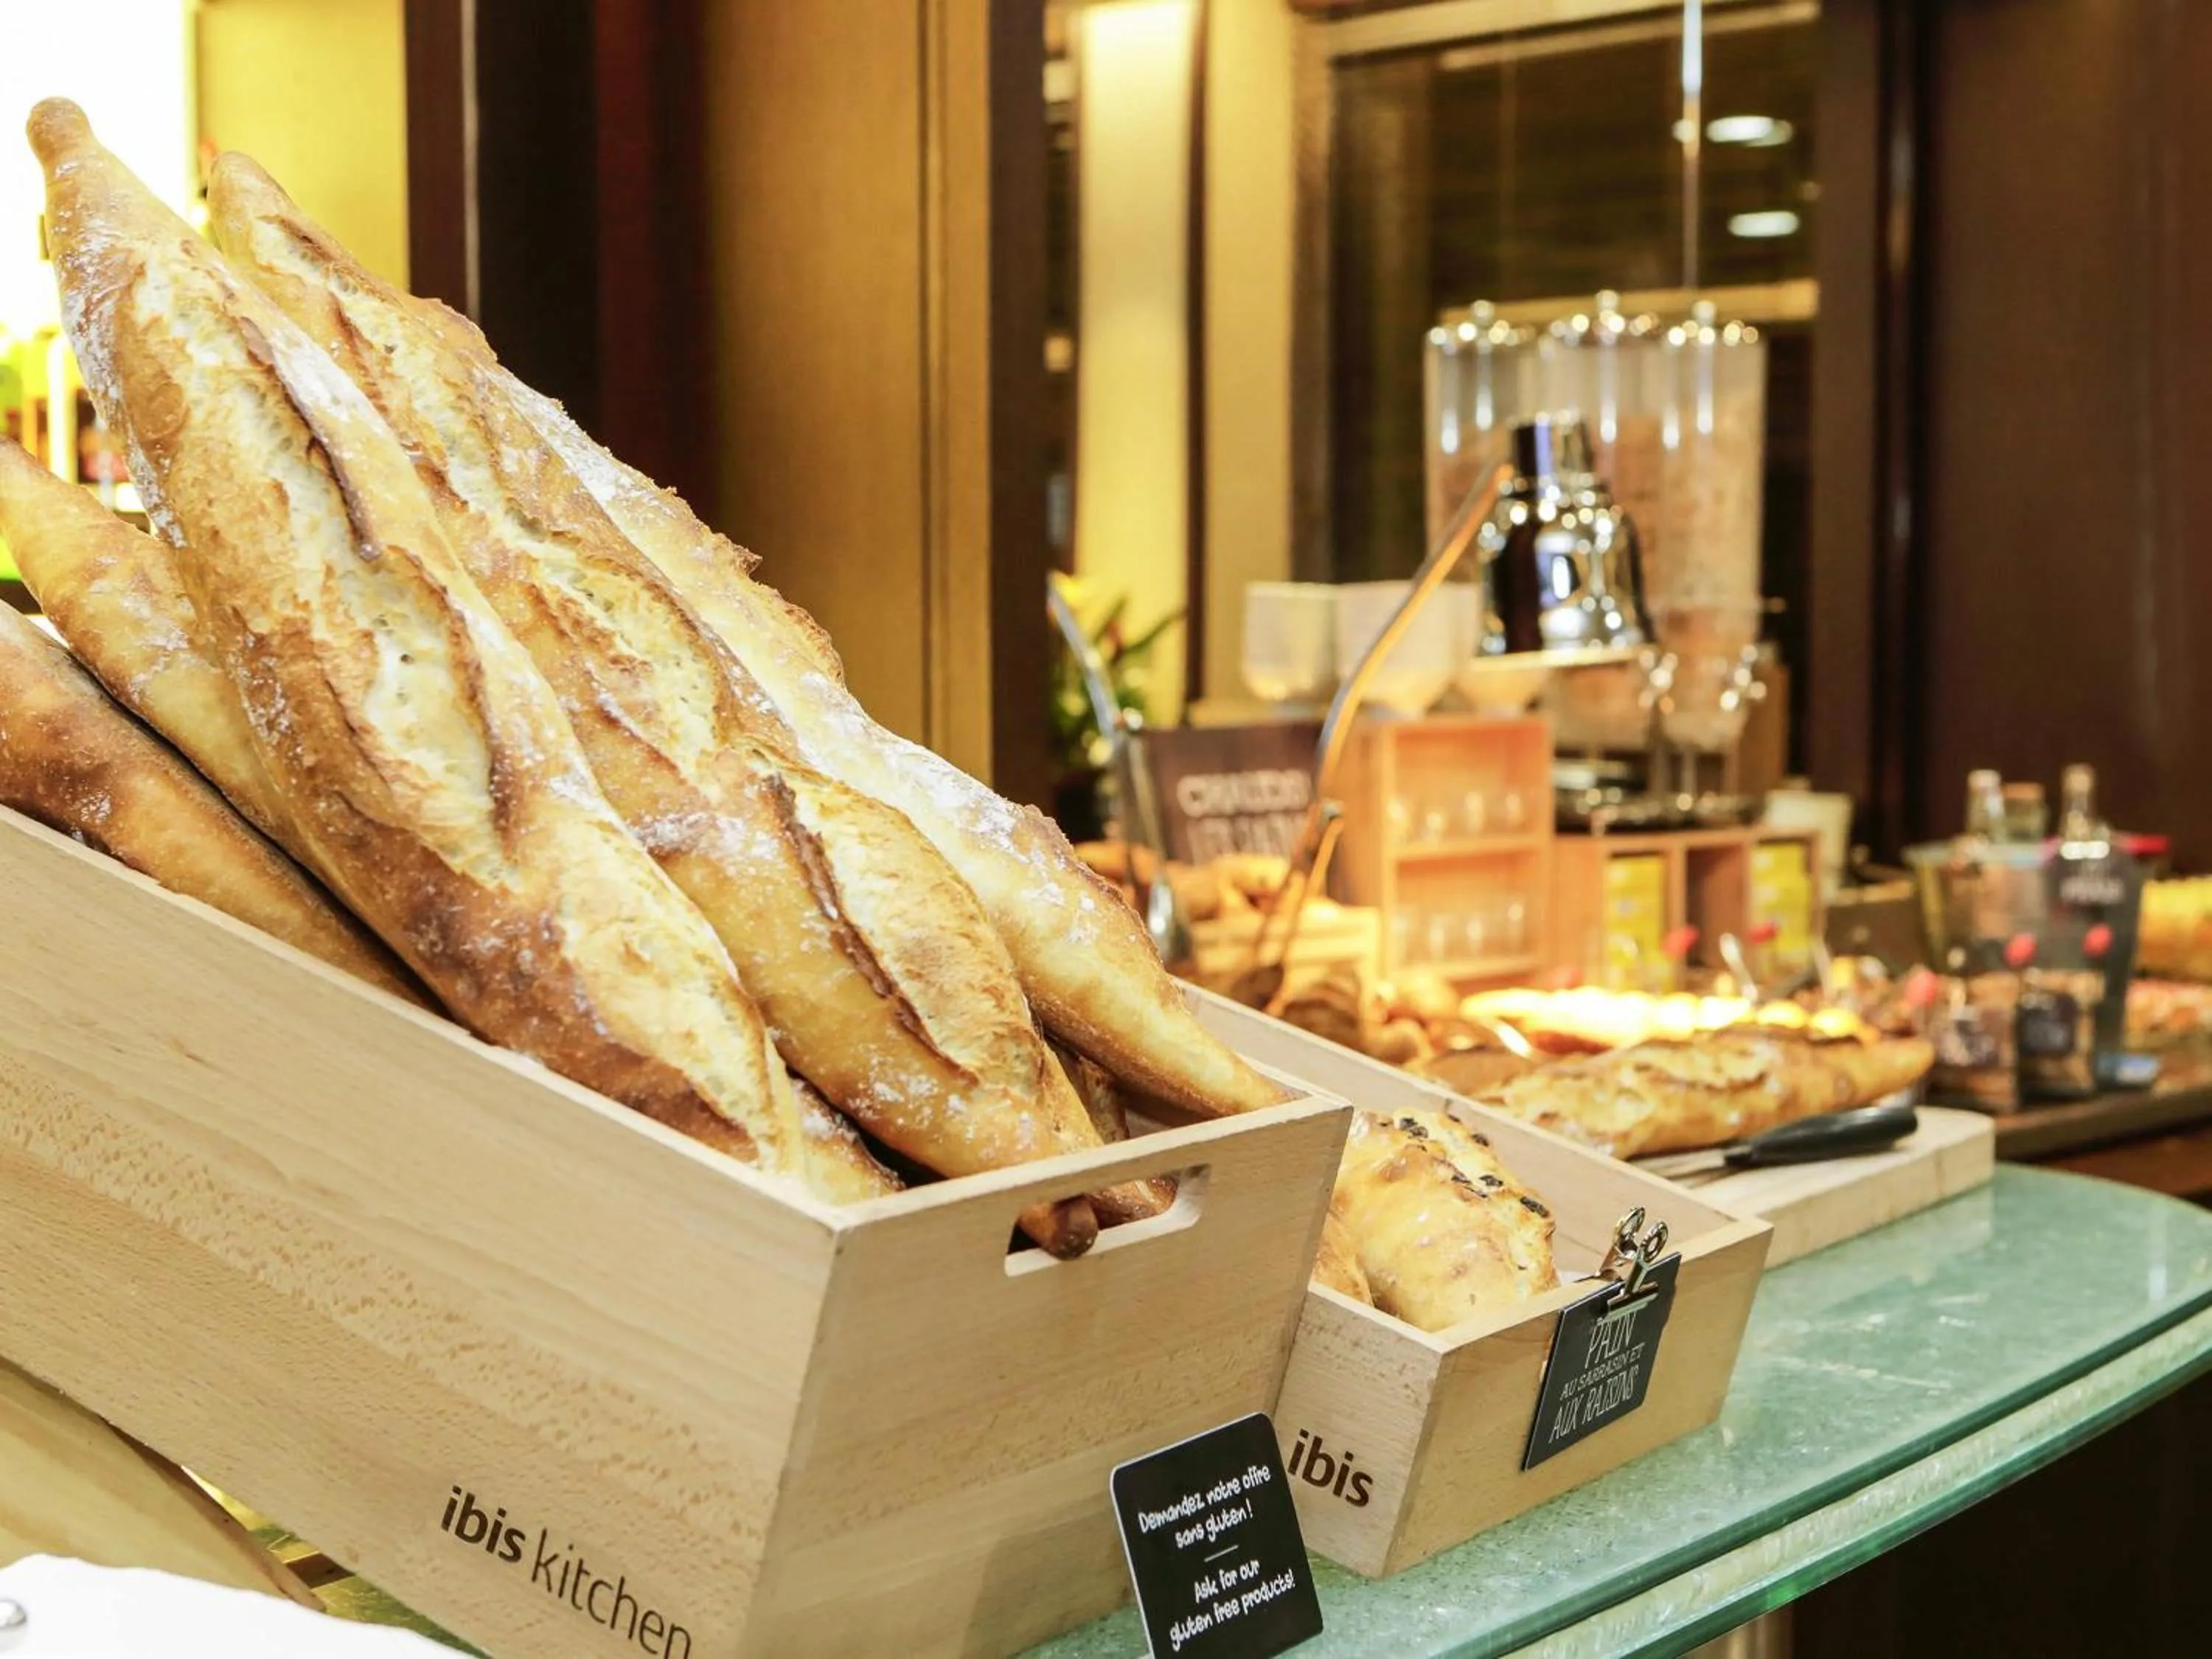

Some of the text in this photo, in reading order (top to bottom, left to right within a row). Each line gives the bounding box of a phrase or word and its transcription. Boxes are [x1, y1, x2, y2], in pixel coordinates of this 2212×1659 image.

[1549, 1365, 1639, 1443] AUX RAISINS
[1560, 1378, 1578, 1401] AU
[1630, 1342, 1646, 1363] ET
[1138, 1465, 1271, 1533] Demandez notre offre
[1287, 1428, 1373, 1506] ibis
[1175, 1523, 1204, 1548] sans
[1206, 1507, 1246, 1542] gluten
[441, 1485, 691, 1659] ibis kitchen
[1194, 1559, 1260, 1604] Ask for our
[1169, 1568, 1295, 1652] gluten free products!
